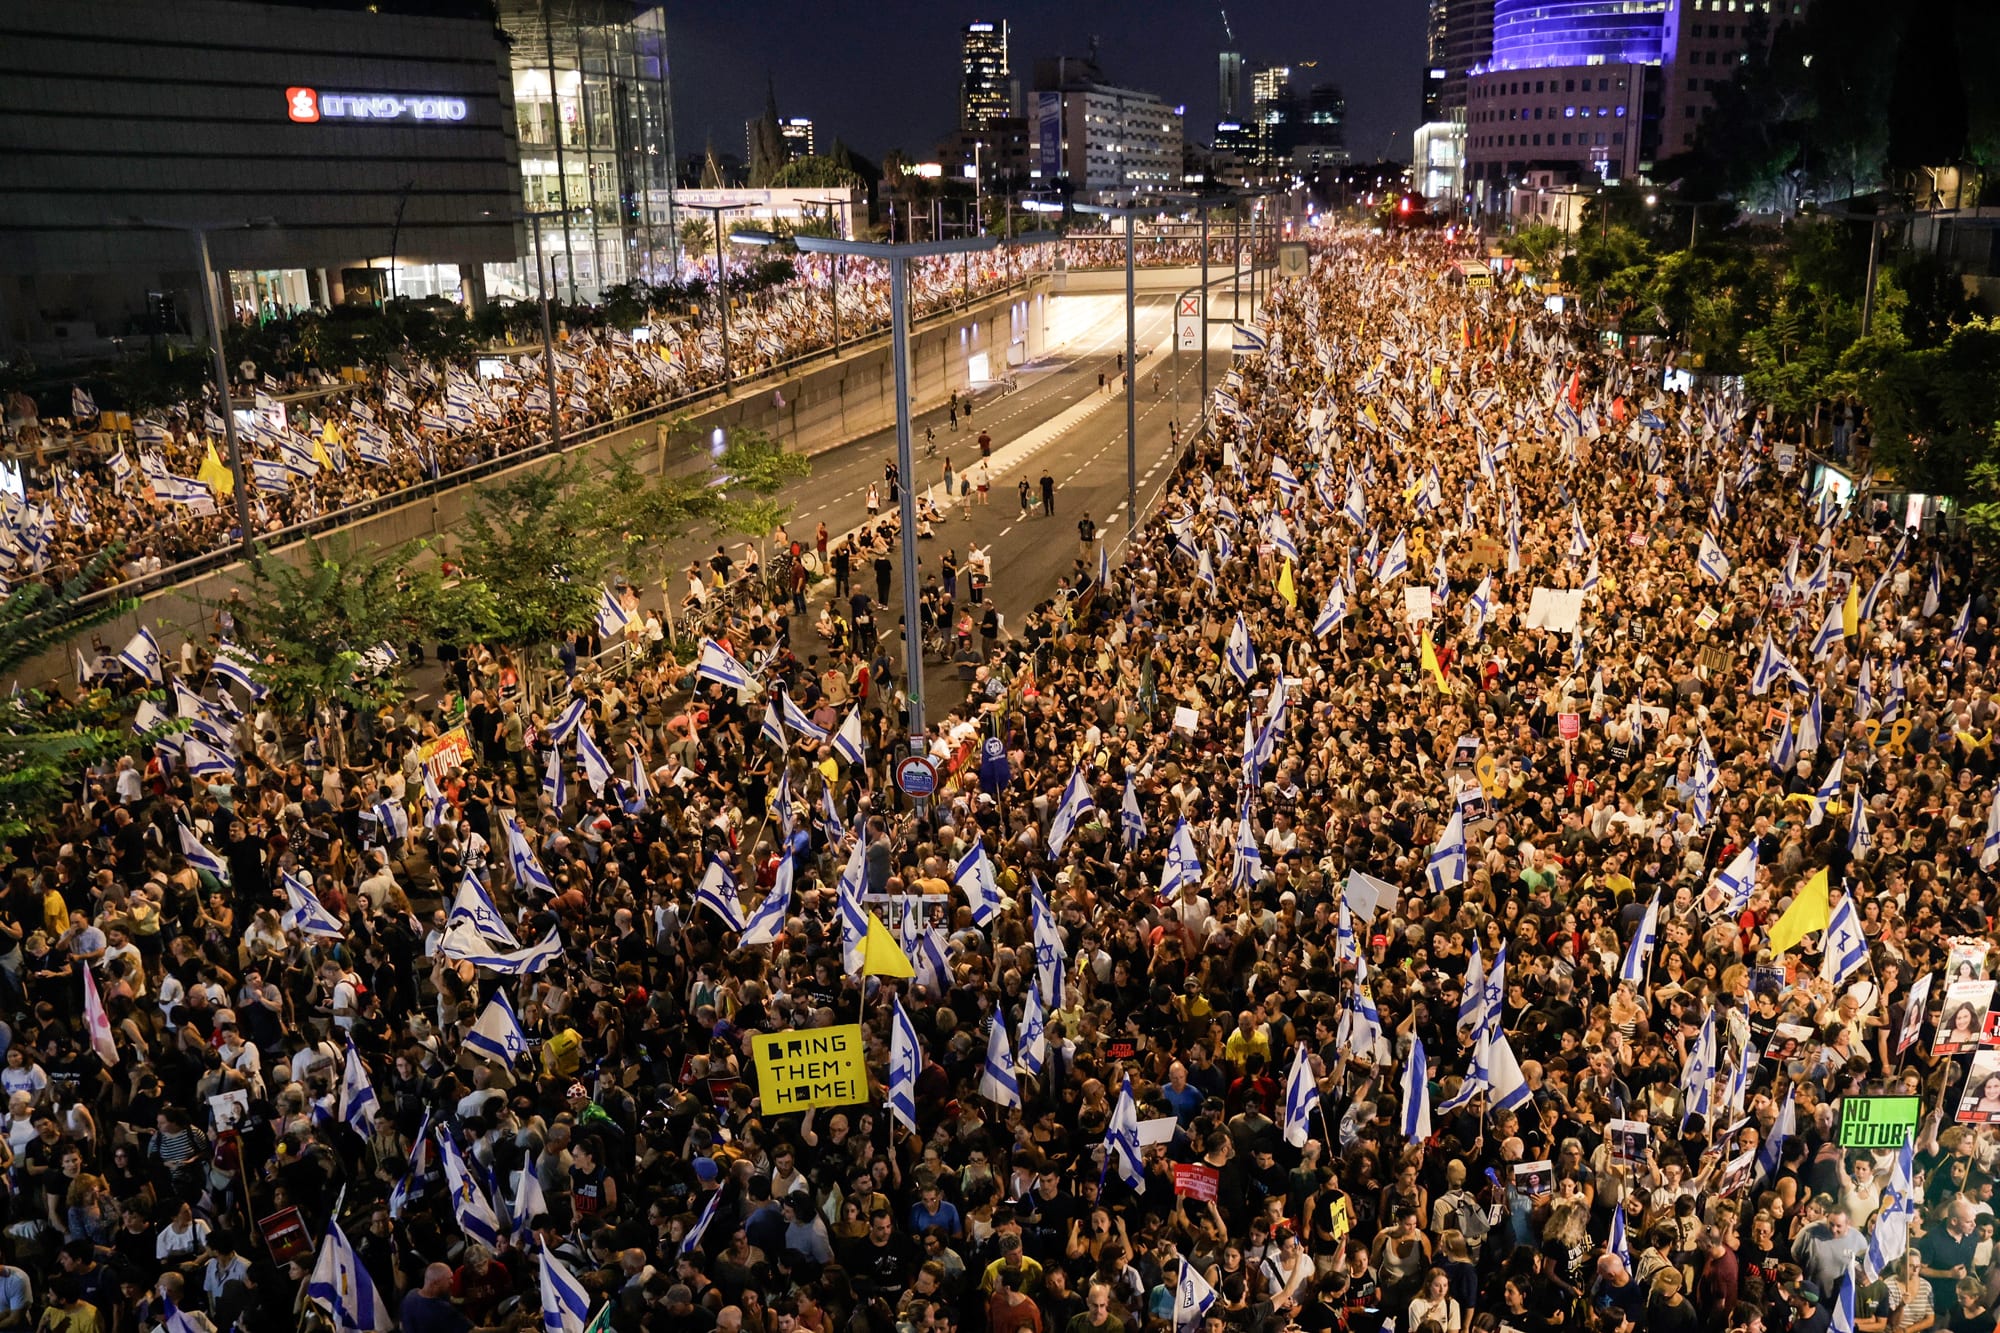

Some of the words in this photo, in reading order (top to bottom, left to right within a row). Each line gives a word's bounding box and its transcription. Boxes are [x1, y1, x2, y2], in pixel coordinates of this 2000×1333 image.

[322, 95, 466, 120] סופר-פארם
[768, 1035, 846, 1061] BRING
[771, 1060, 839, 1081] THEM
[776, 1080, 856, 1104] HOME!
[1846, 1100, 1871, 1121] NO
